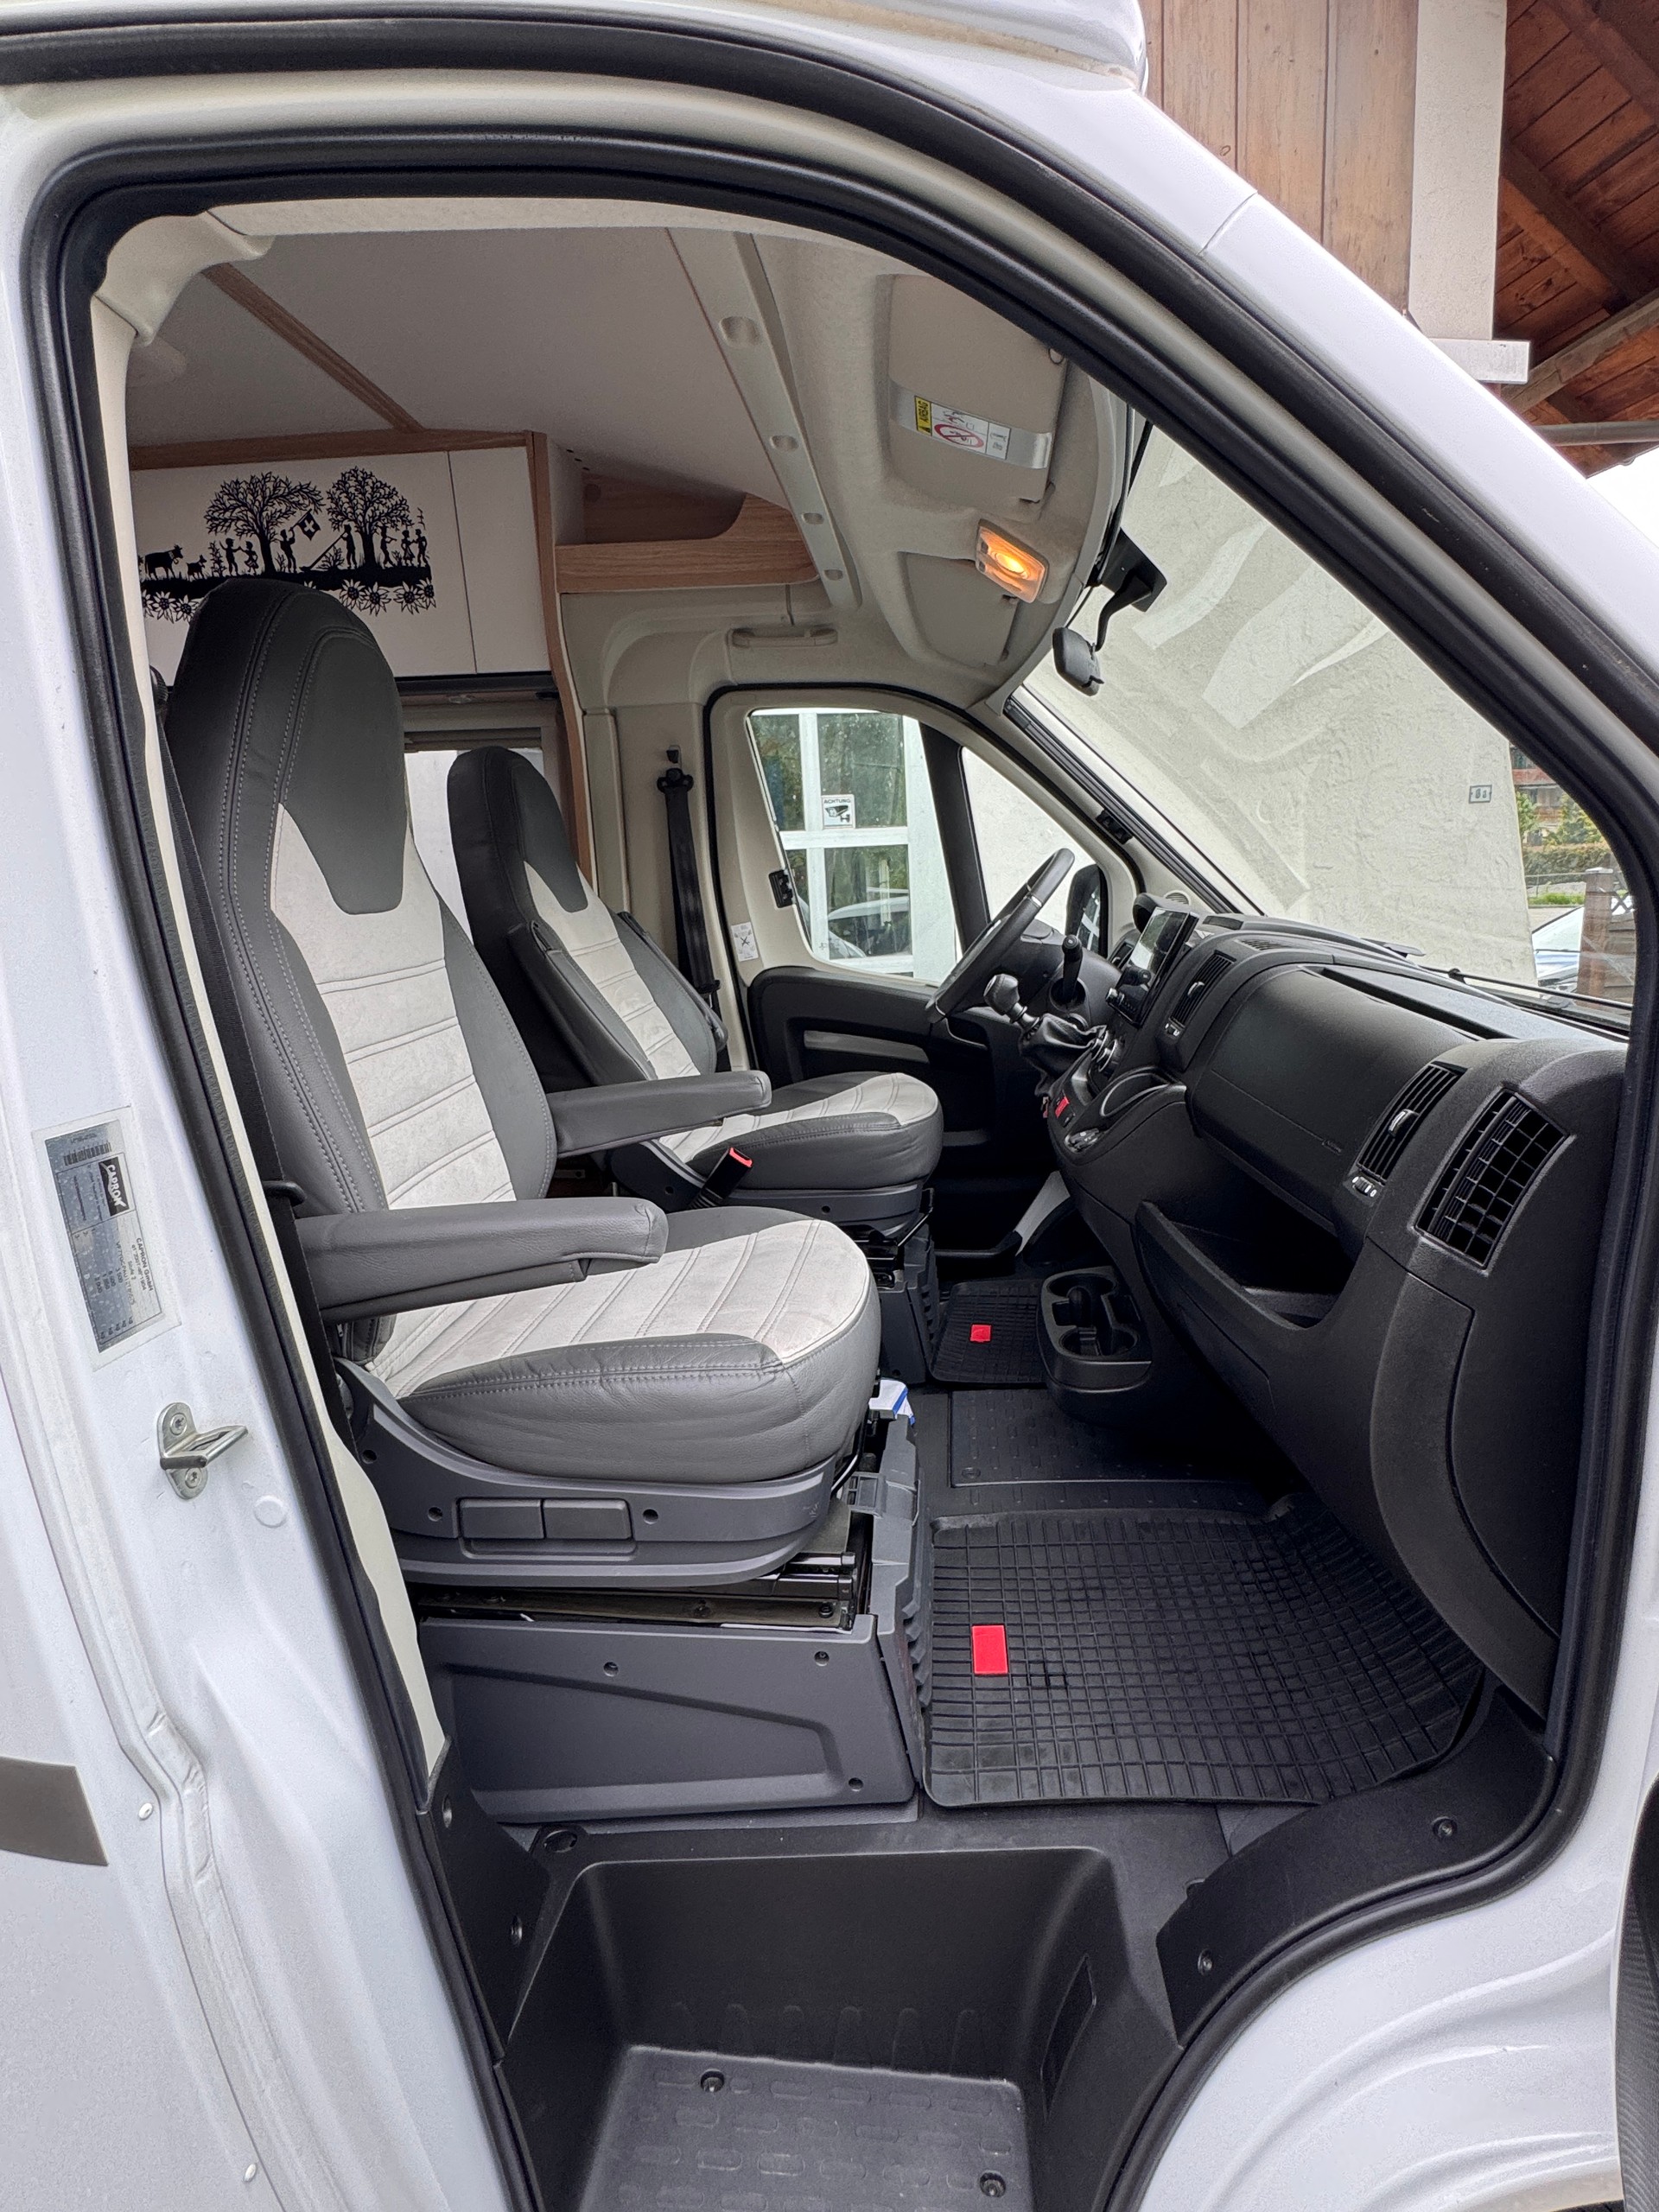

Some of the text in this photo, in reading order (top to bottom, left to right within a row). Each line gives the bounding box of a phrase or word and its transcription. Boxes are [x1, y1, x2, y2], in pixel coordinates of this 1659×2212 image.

[106, 1164, 127, 1207] CAPRON
[136, 1237, 154, 1291] CAPRON GmbH
